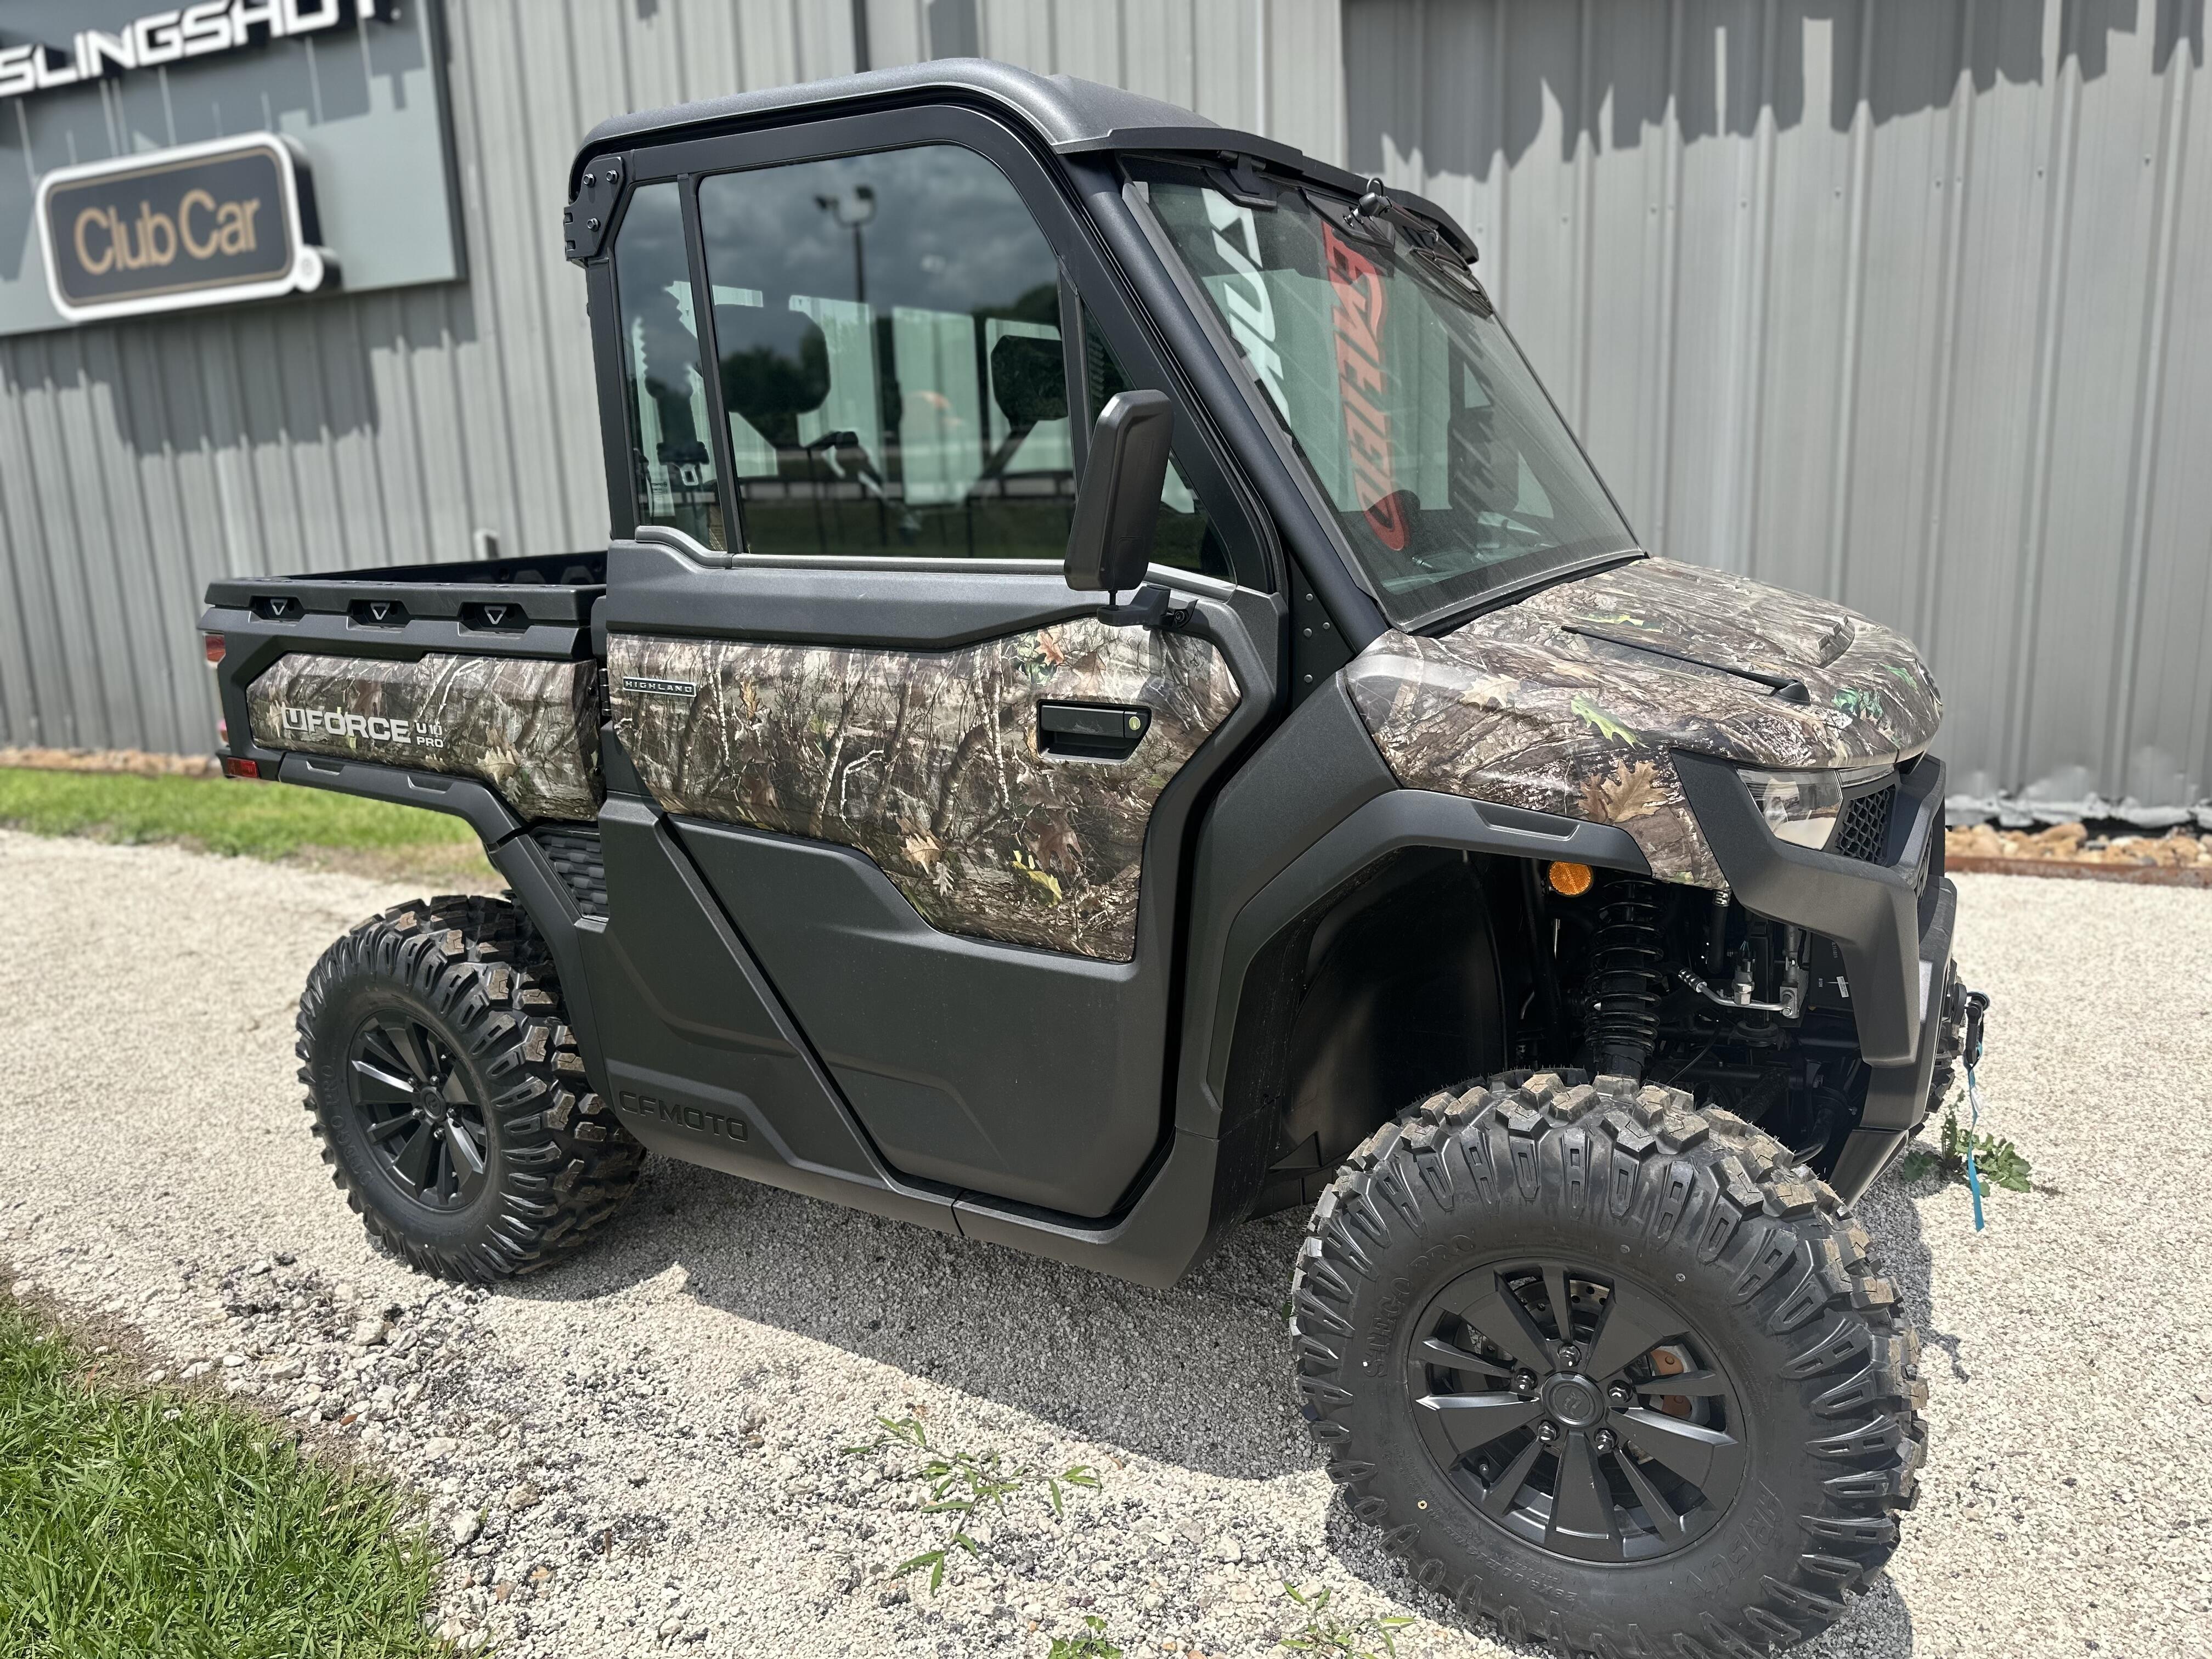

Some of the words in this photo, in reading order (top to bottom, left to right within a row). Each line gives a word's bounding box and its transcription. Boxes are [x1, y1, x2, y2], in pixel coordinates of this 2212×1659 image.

[74, 201, 177, 275] Club
[178, 189, 261, 259] Car
[625, 680, 692, 692] HIGHLAND
[416, 736, 444, 748] PRO
[320, 1064, 340, 1107] PRO
[619, 1091, 748, 1143] CFMOTO
[330, 1115, 374, 1187] STEGO
[1363, 1277, 1414, 1378] STEGO
[1407, 1234, 1476, 1282] PRO
